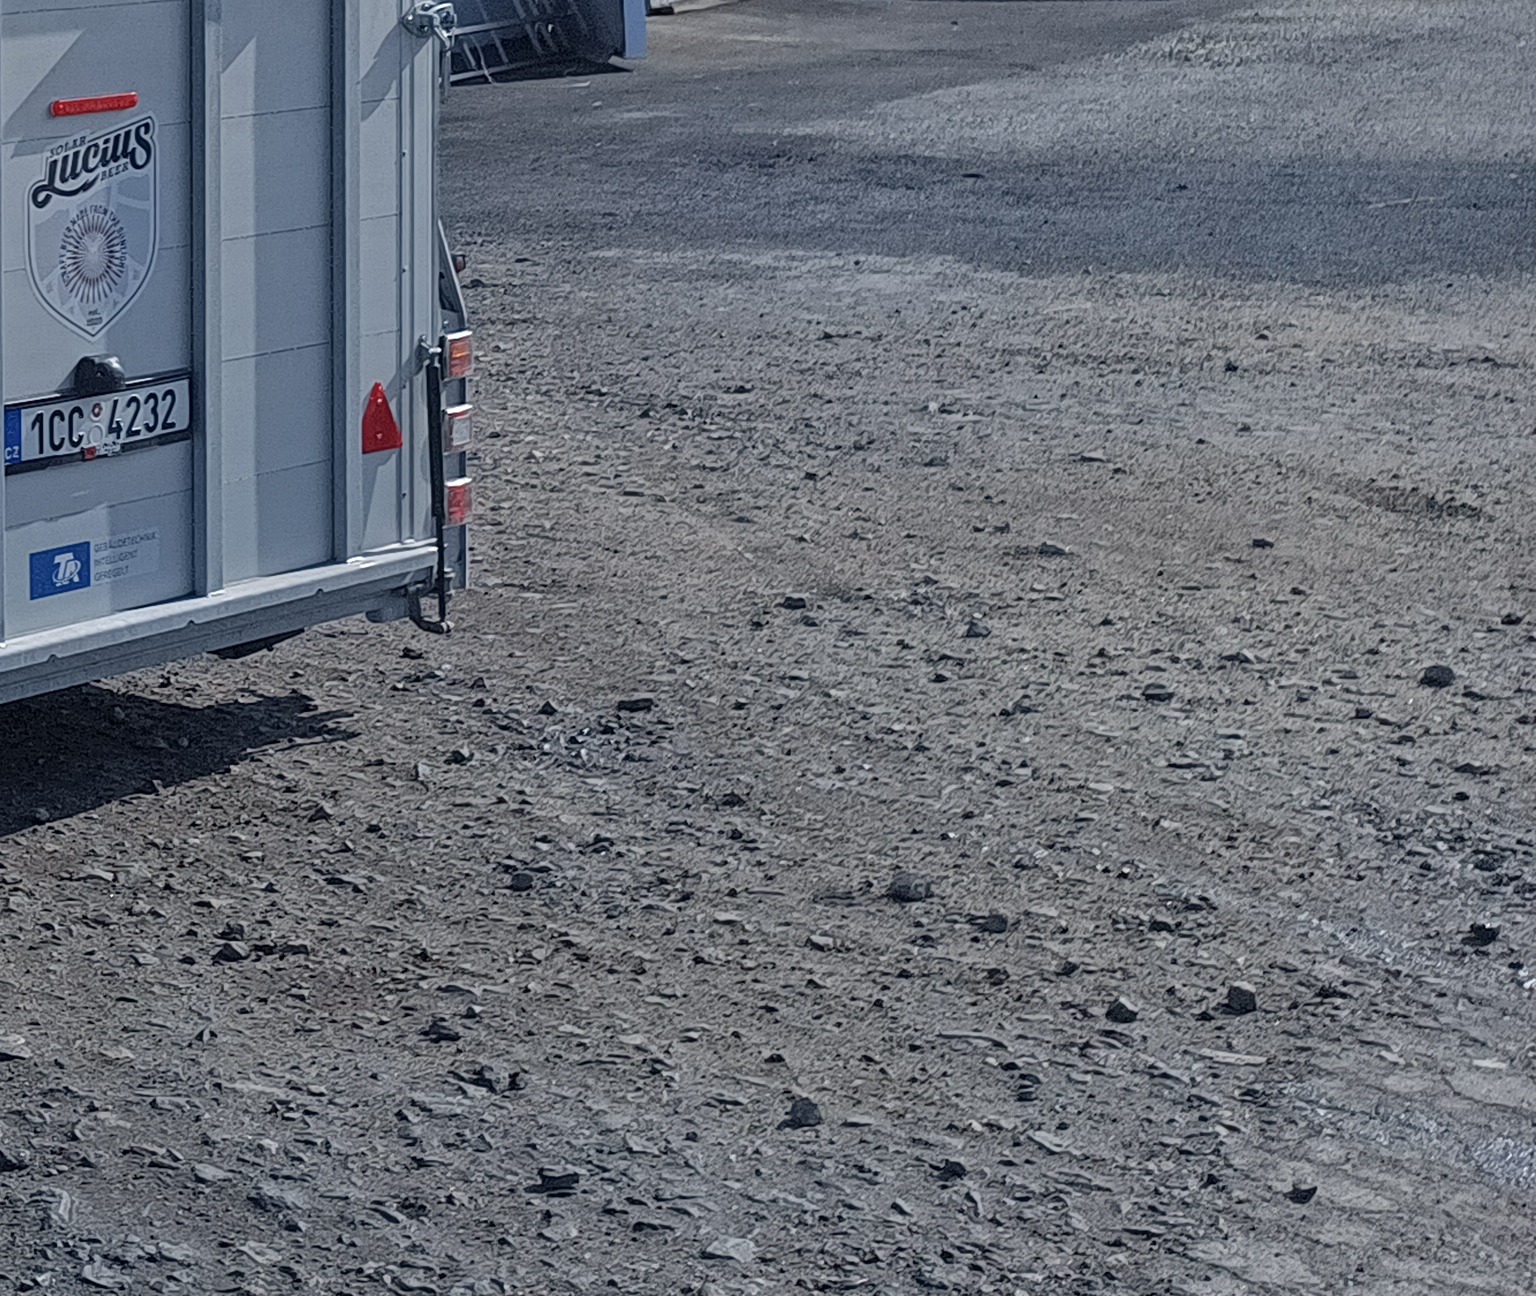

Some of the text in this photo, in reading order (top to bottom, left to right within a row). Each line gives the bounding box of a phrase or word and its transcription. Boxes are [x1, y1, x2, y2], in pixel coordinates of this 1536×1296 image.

[49, 135, 87, 158] SOLAR
[100, 161, 129, 182] BEER
[30, 388, 177, 455] 1CC 4232
[4, 446, 20, 460] CZ
